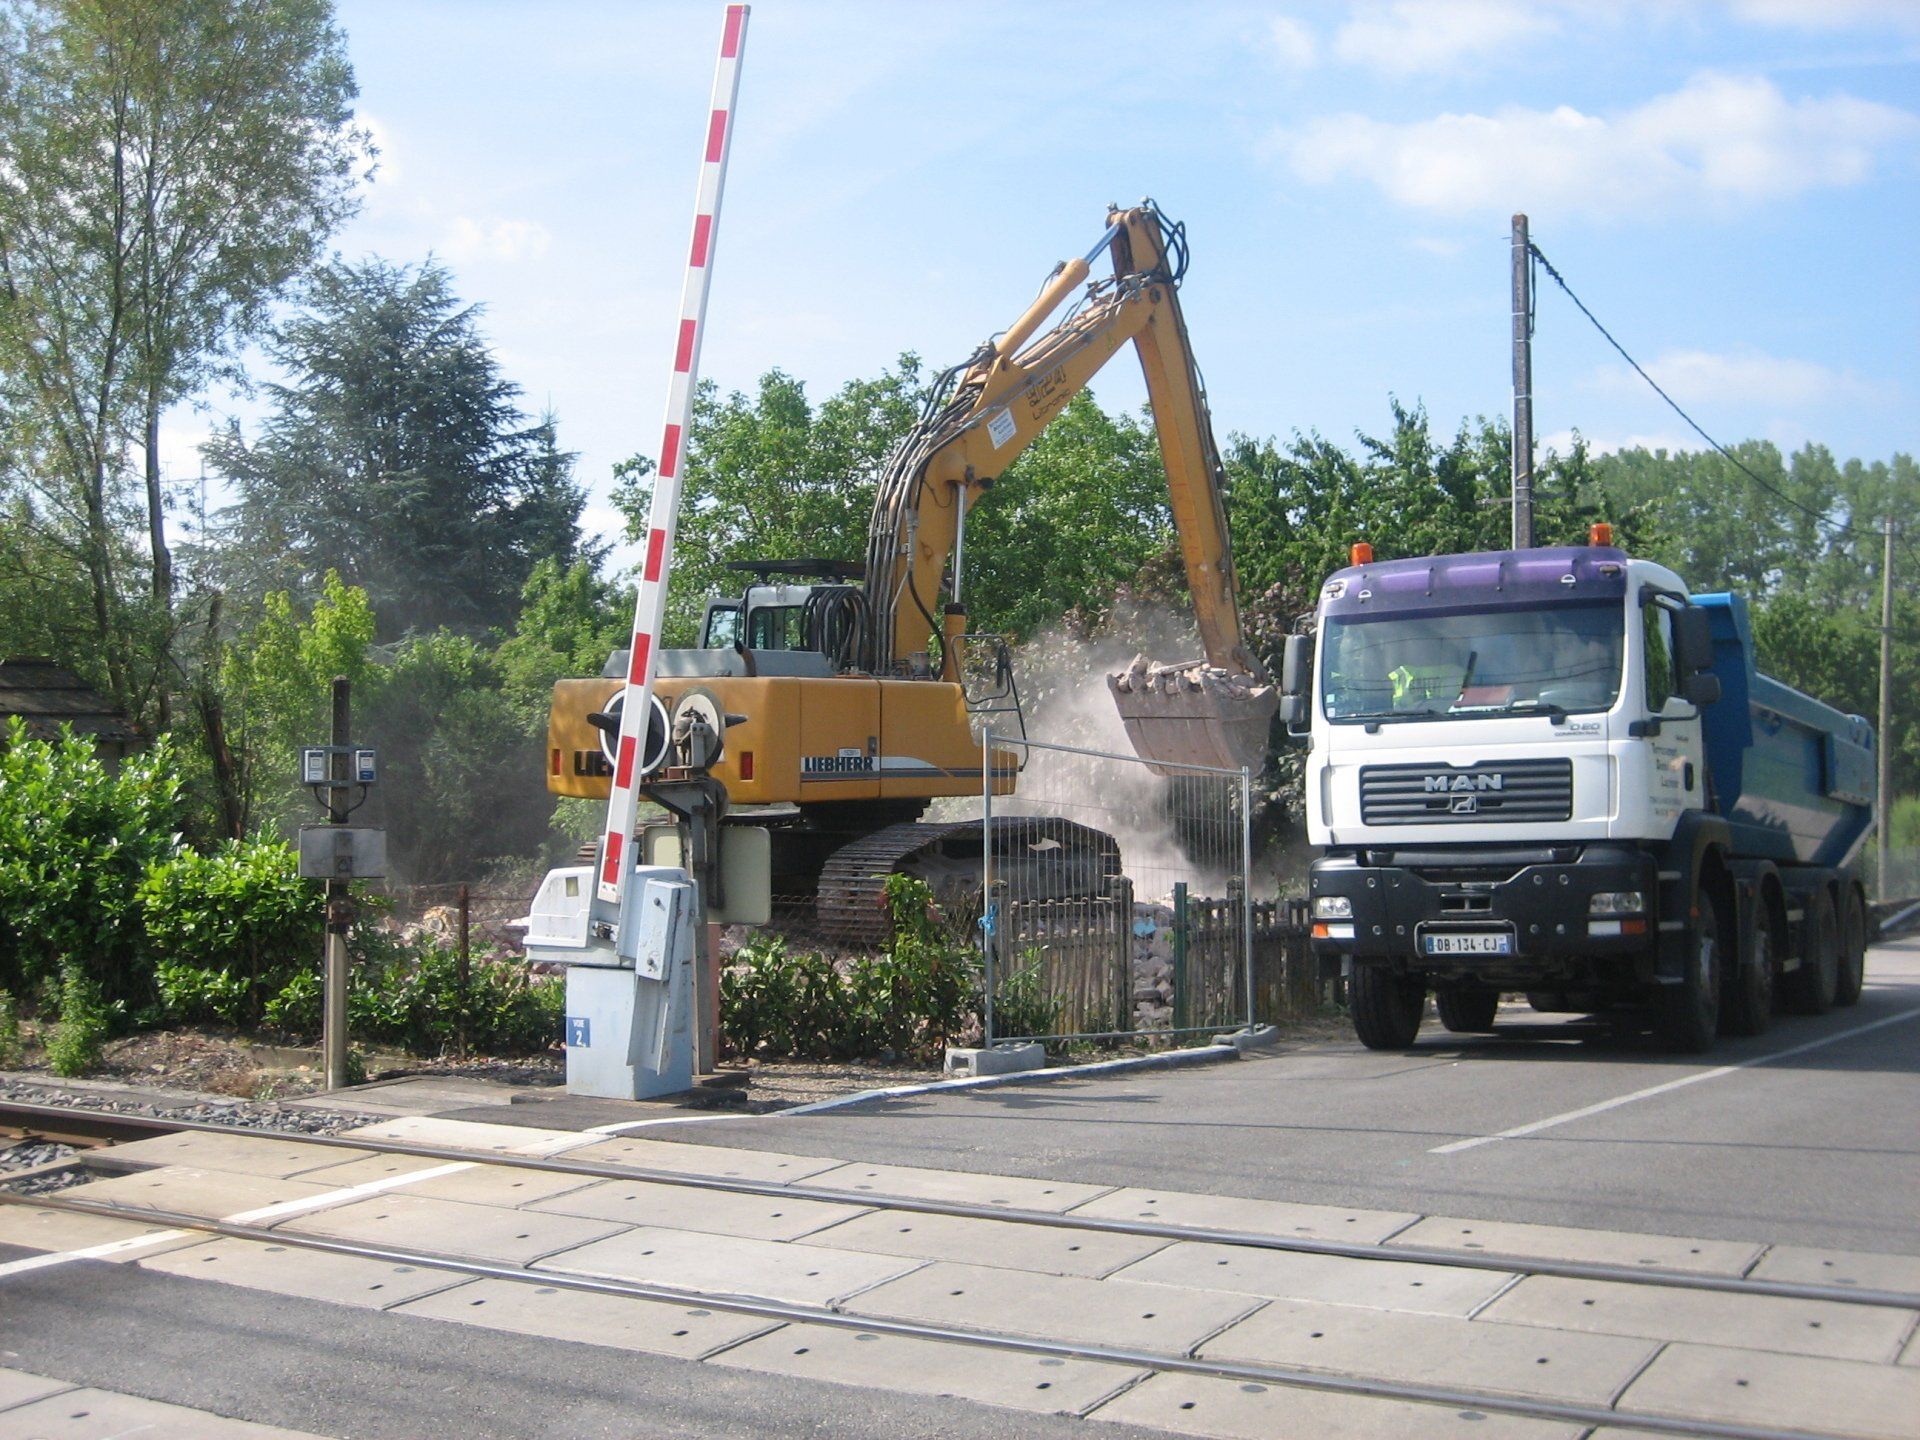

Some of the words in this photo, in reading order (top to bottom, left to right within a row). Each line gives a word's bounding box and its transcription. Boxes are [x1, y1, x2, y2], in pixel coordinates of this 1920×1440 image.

[804, 756, 874, 772] LIEBHERR
[1424, 773, 1502, 792] MAN
[575, 1030, 583, 1046] 2
